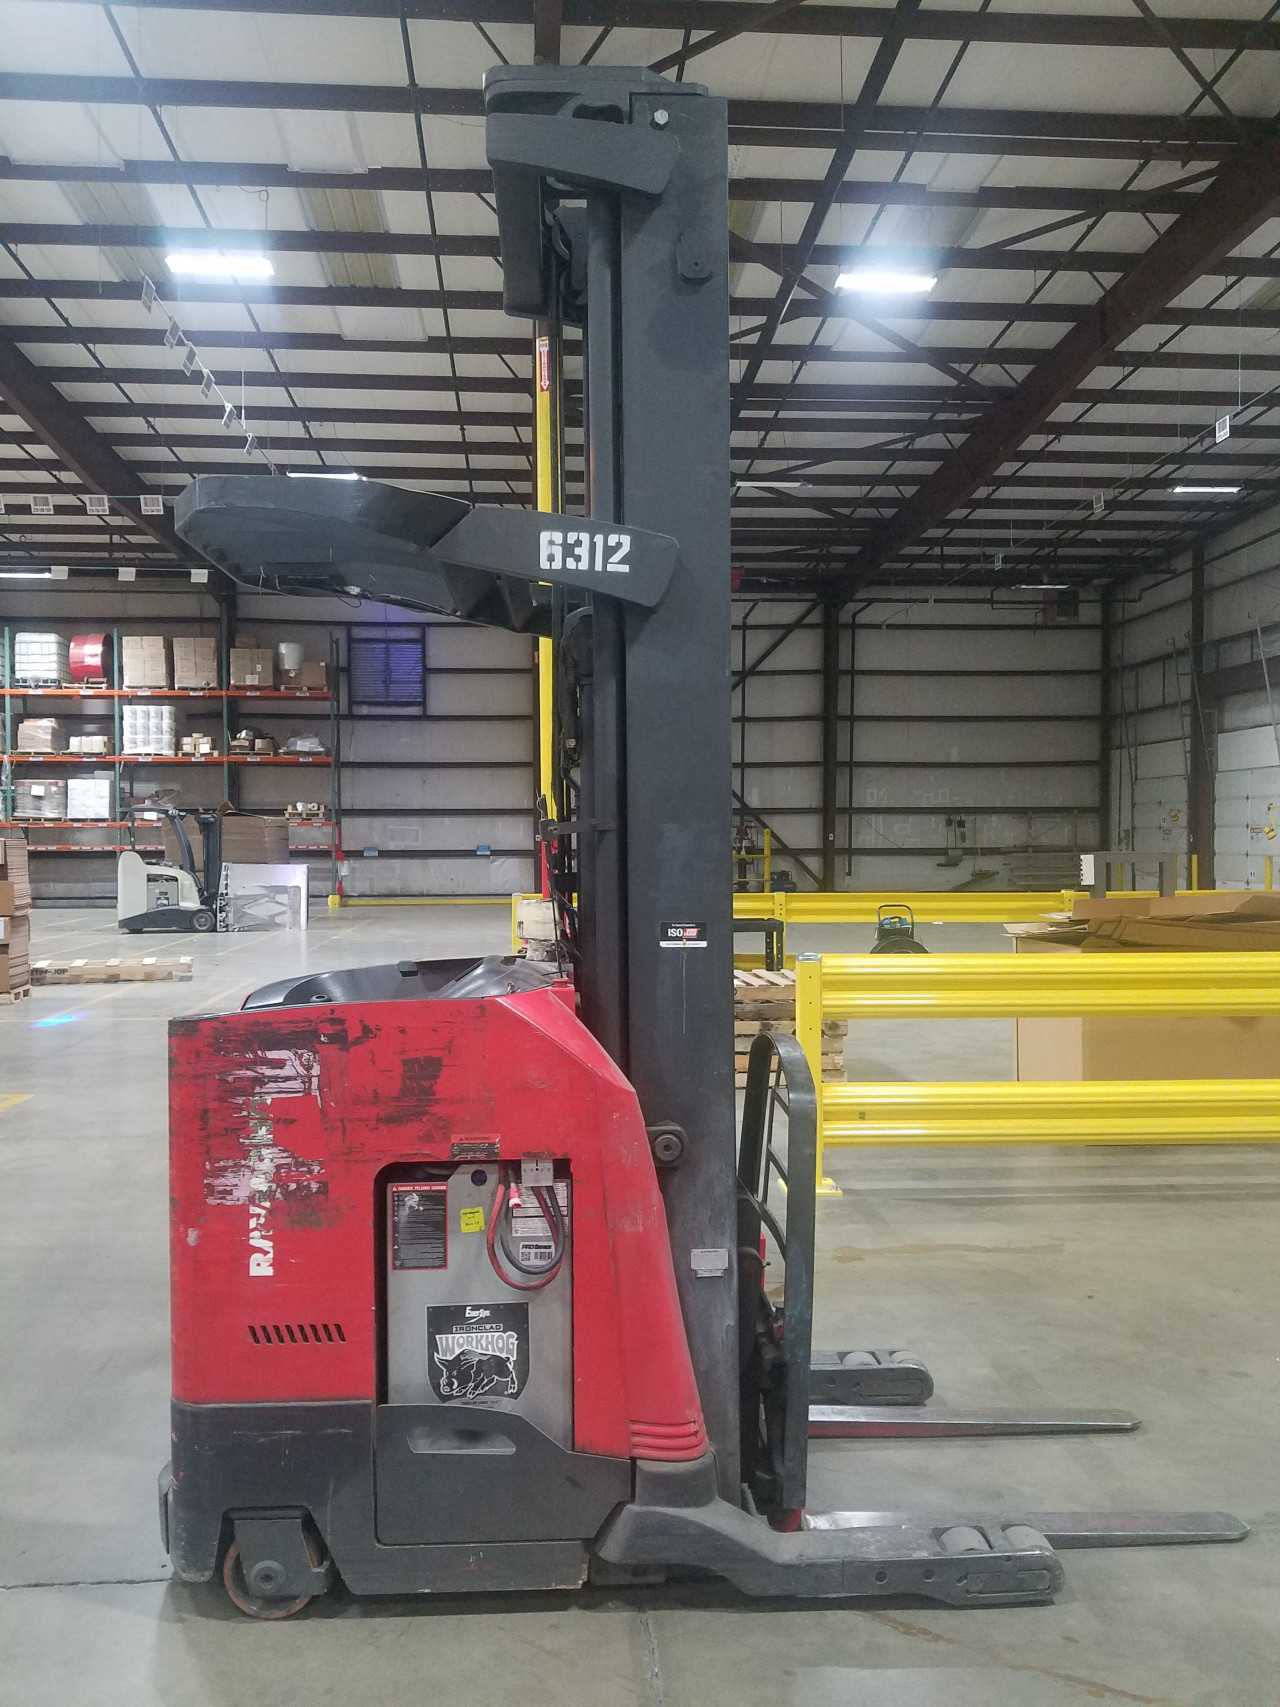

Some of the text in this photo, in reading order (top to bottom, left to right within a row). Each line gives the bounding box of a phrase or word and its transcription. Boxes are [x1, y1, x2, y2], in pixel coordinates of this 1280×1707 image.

[539, 531, 631, 573] 6312
[667, 928, 683, 936] ISO
[454, 1324, 502, 1332] IRONCLAD
[436, 1331, 518, 1360] WORKHOG
